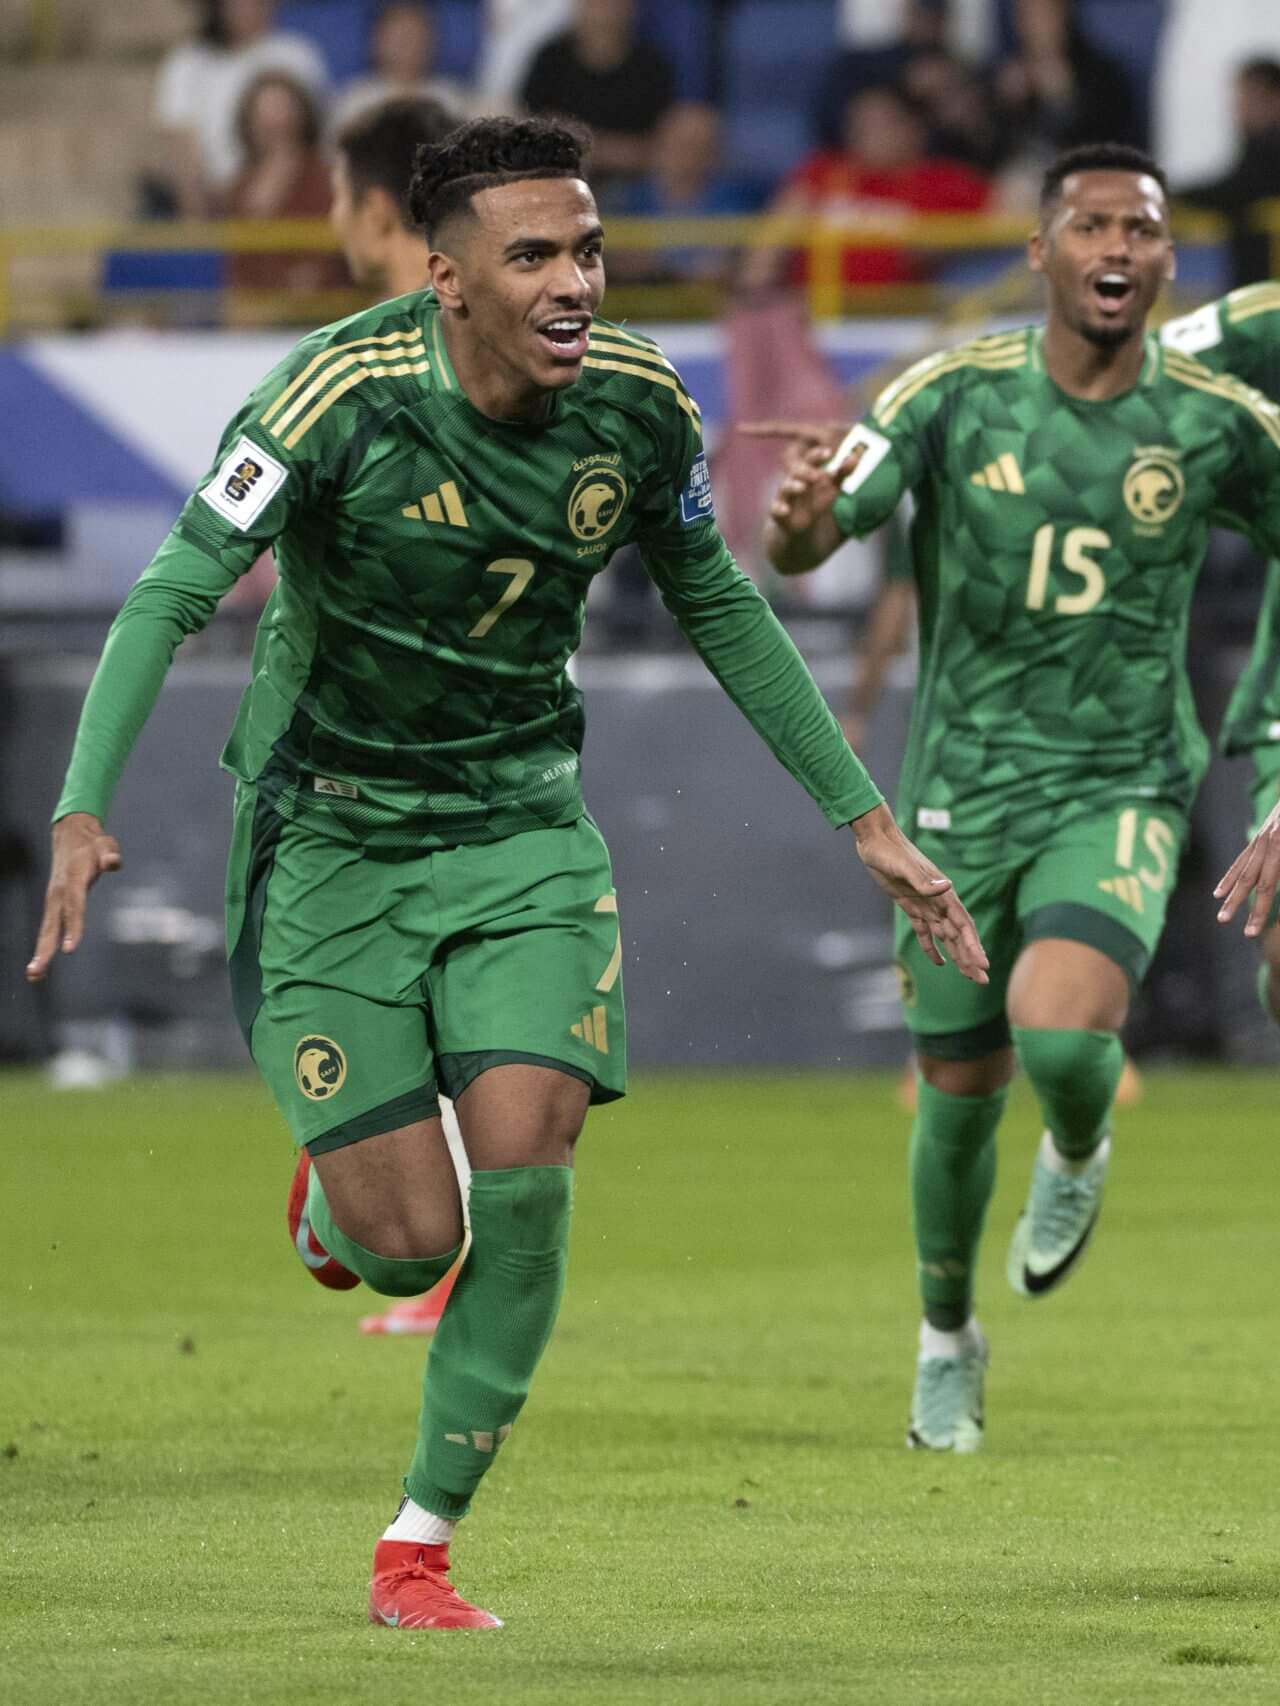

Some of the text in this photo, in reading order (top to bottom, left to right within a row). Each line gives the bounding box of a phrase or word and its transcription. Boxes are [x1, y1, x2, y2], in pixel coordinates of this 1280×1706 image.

[576, 542, 608, 558] SAUDI
[1026, 523, 1111, 615] 15
[467, 557, 535, 639] 7
[1115, 808, 1175, 891] 15
